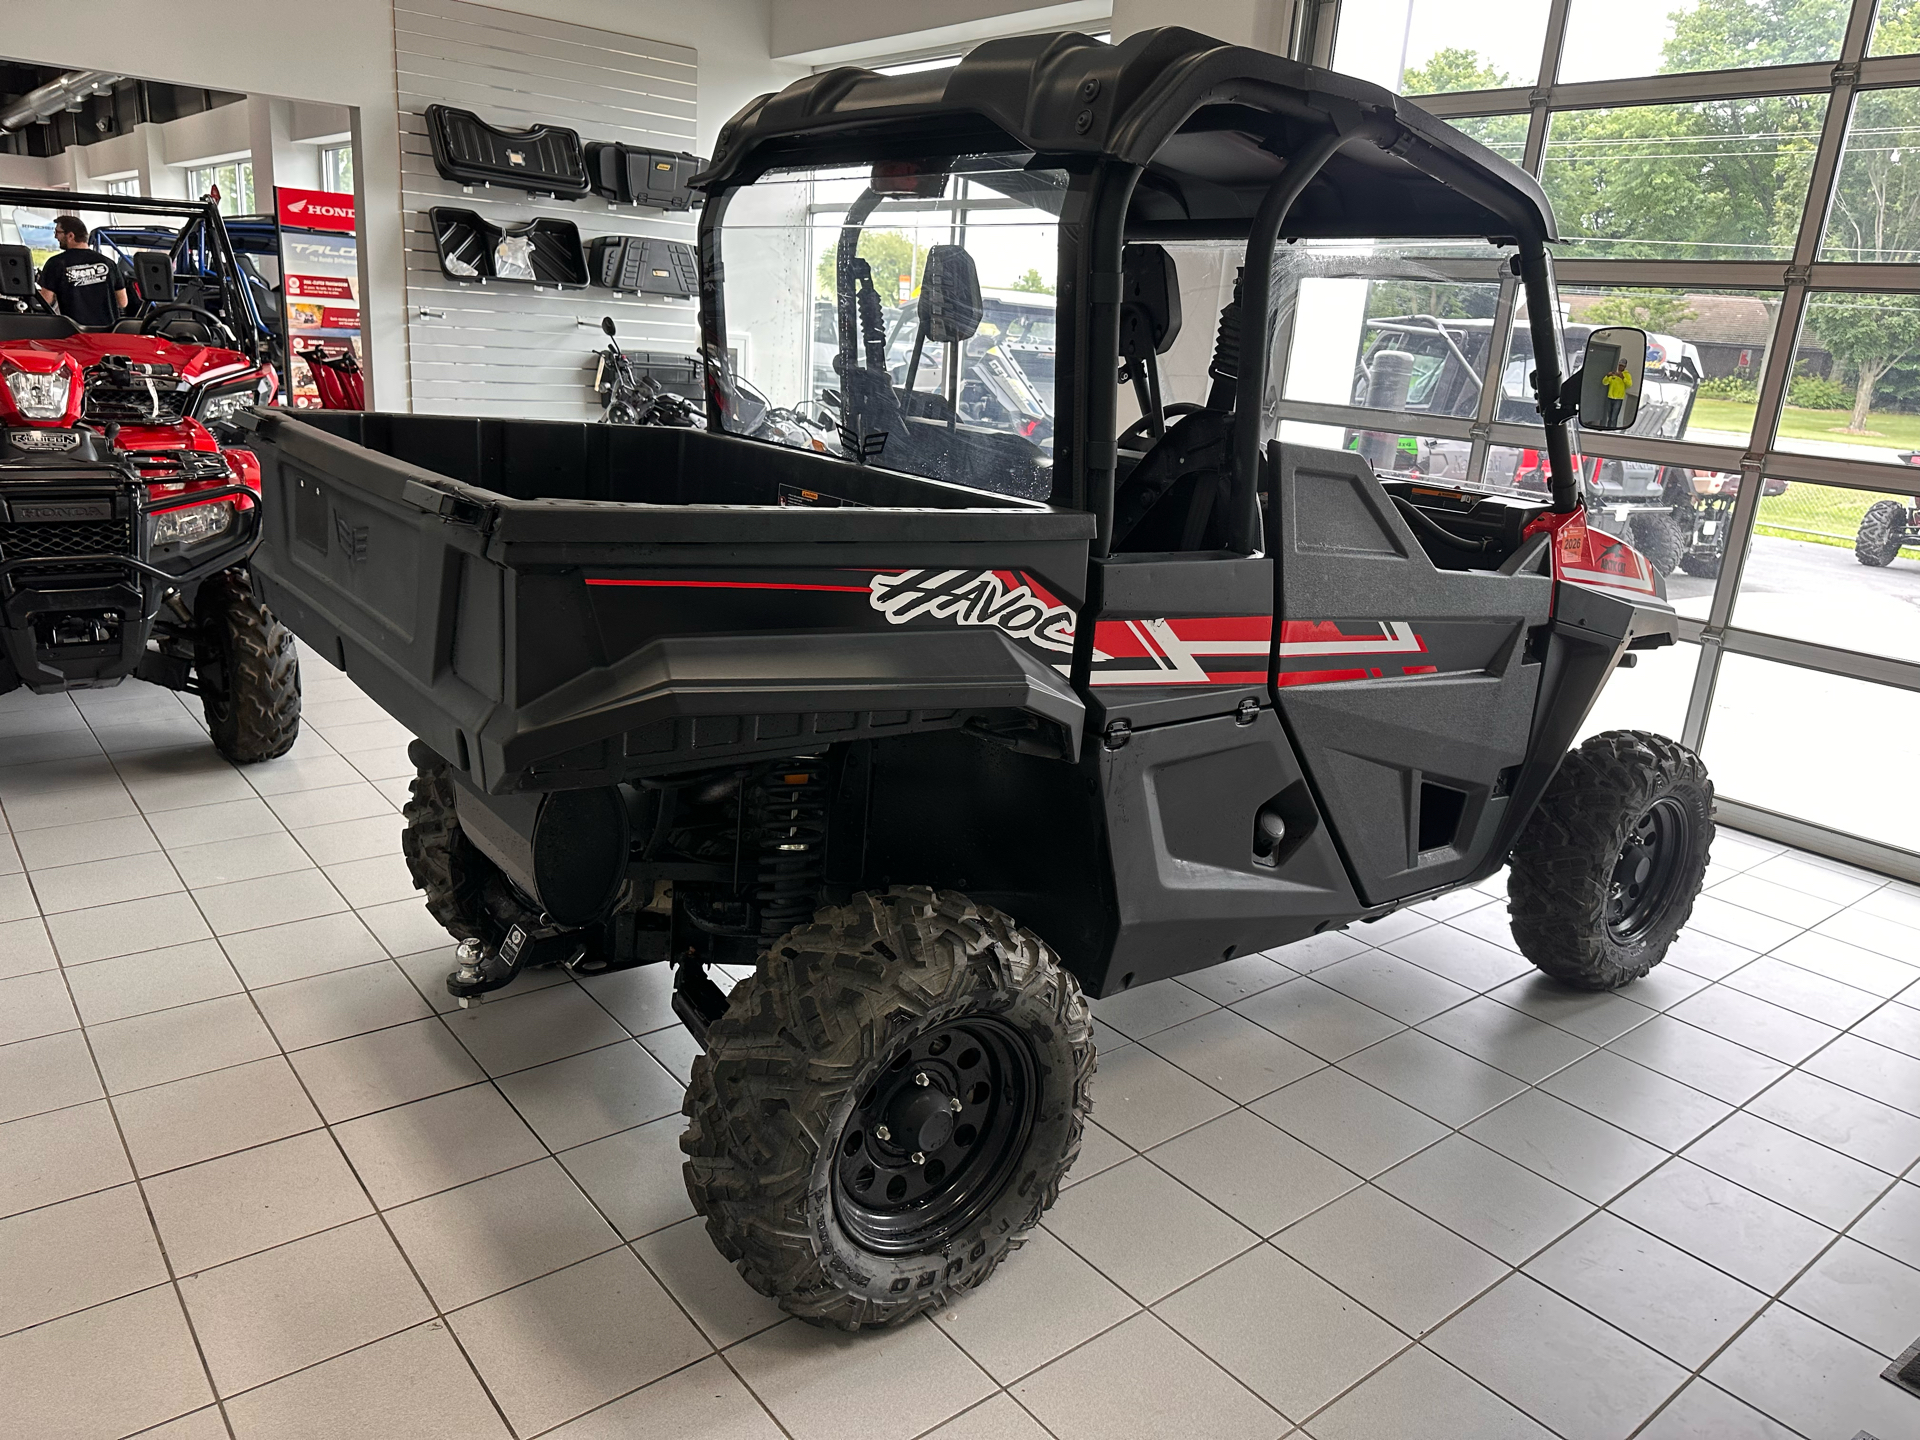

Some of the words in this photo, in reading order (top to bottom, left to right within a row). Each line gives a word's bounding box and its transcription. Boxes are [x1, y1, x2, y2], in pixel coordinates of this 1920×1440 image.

[21, 506, 104, 518] HONDA
[1564, 538, 1581, 549] 2026
[872, 570, 1075, 648] HAVOC
